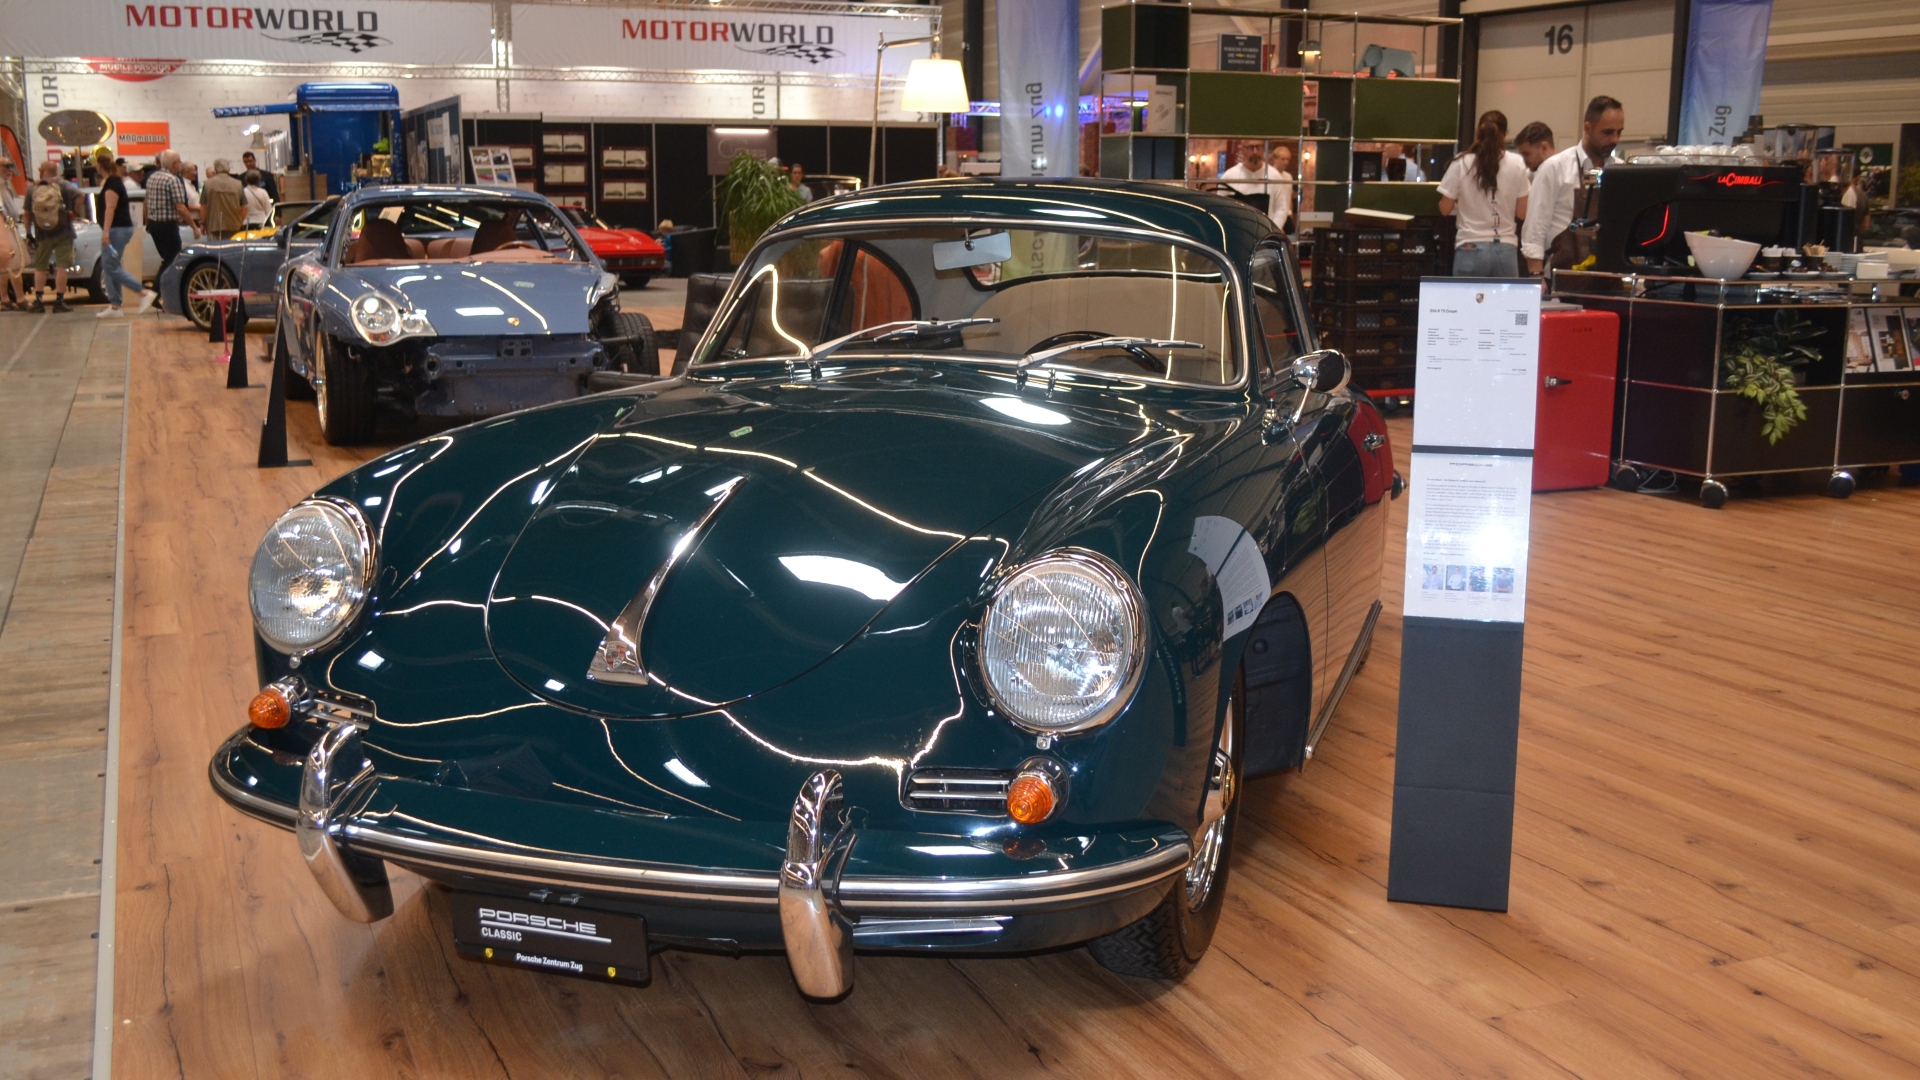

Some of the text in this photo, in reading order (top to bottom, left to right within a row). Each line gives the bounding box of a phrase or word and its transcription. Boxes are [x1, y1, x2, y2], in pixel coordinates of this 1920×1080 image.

[126, 4, 378, 32] MOTORWORLD
[622, 19, 834, 45] MOTORWORLD
[1544, 24, 1573, 55] 16
[1708, 105, 1732, 137] Zug
[479, 907, 597, 935] PORSCHE
[481, 927, 523, 942] CLASSIC
[516, 952, 583, 973] Porsche Zentrum Zug
